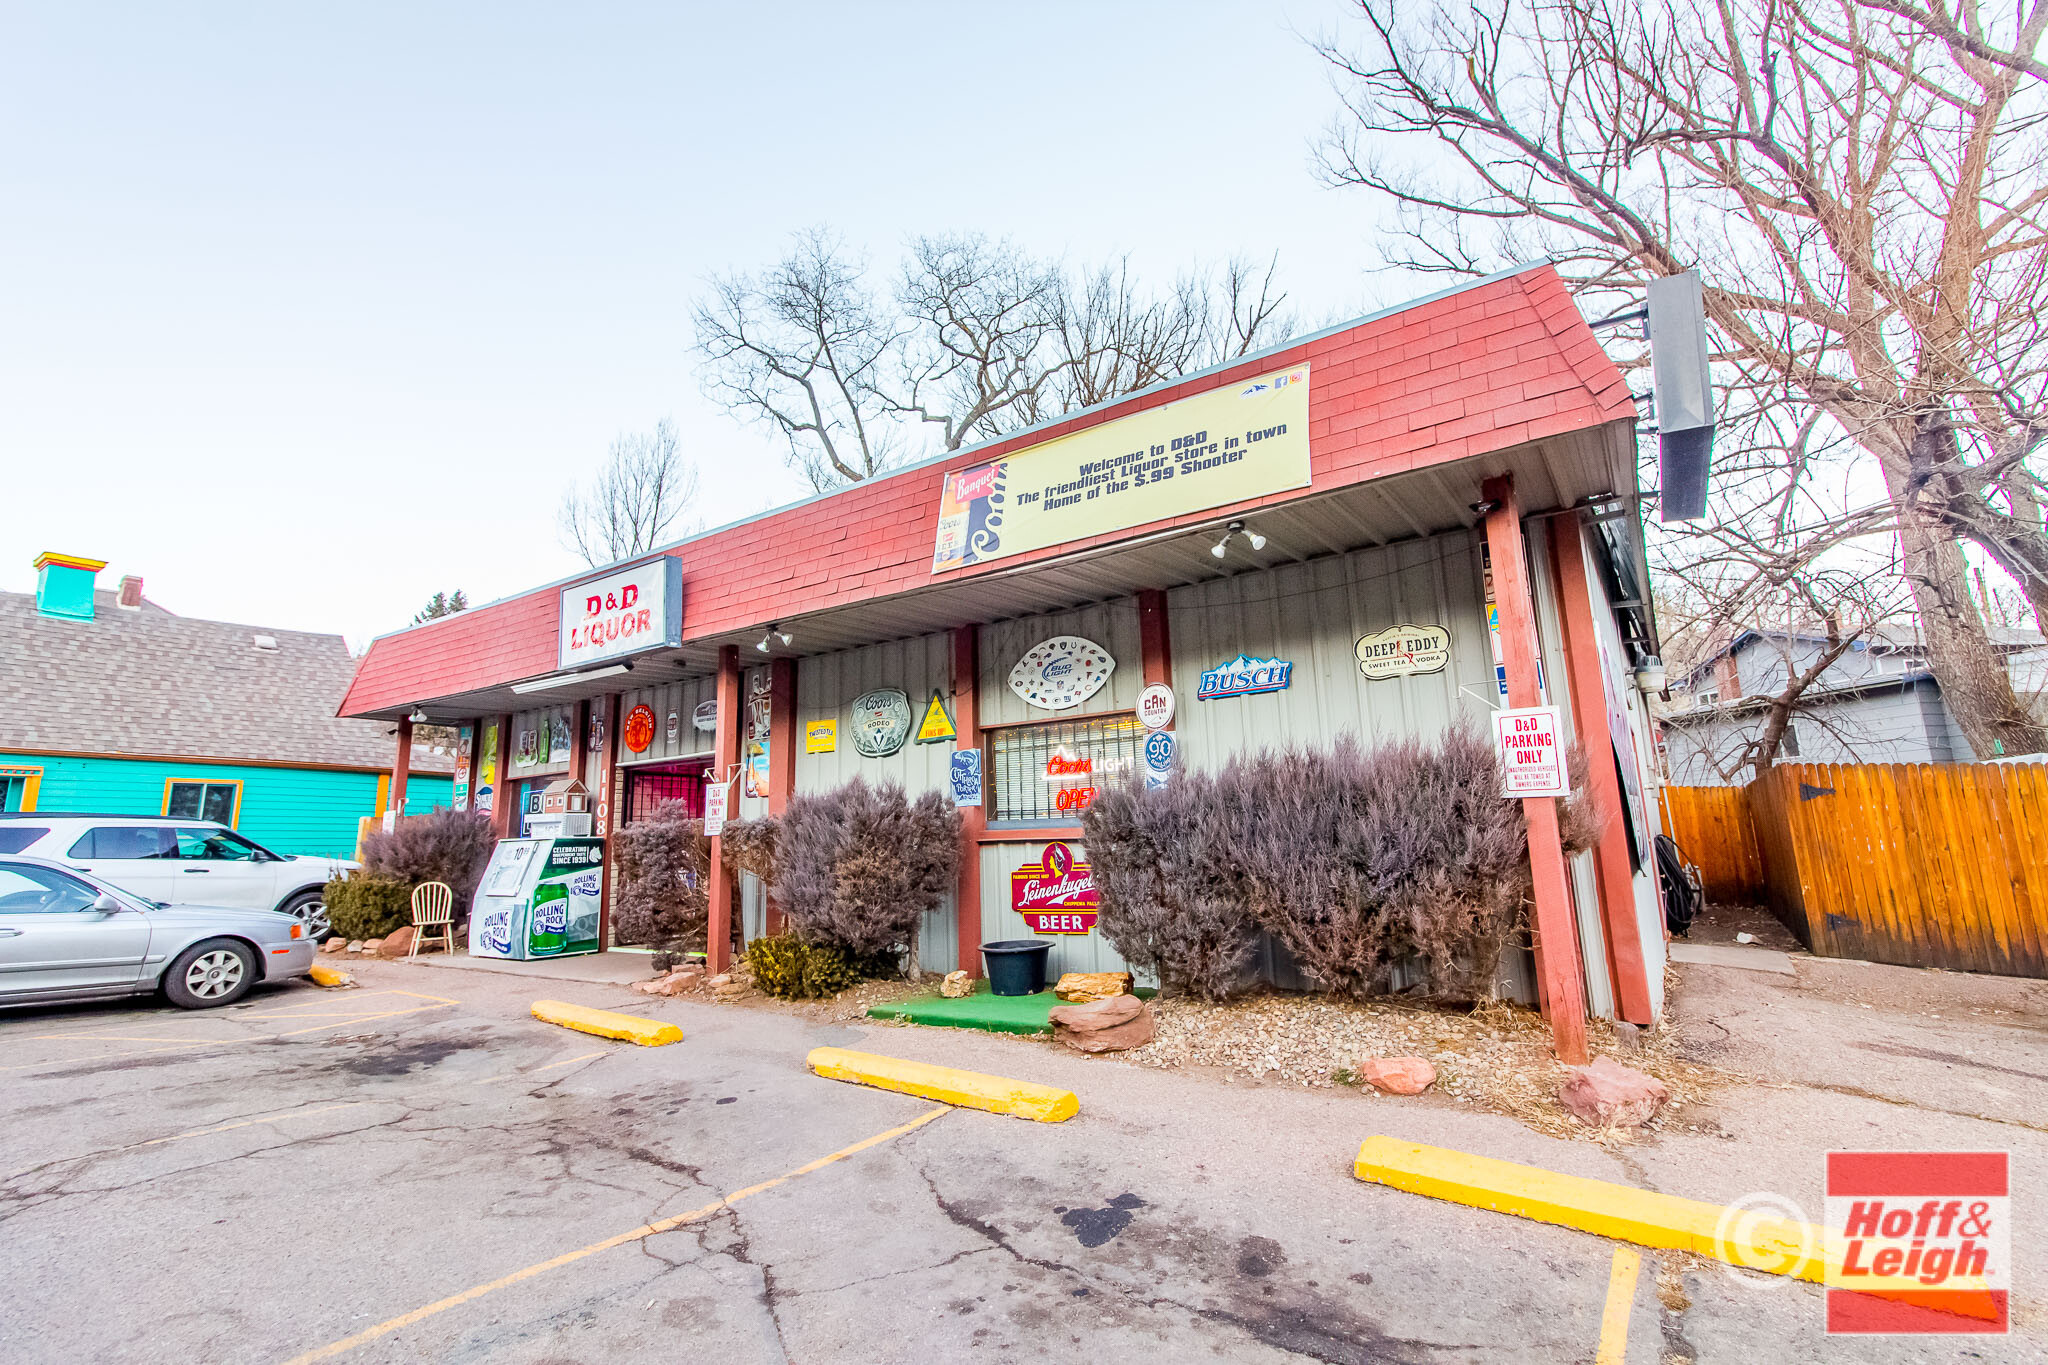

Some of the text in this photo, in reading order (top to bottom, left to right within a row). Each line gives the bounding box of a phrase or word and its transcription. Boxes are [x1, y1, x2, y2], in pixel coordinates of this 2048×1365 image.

[1080, 430, 1207, 476] Welcome to D&D
[1017, 424, 1287, 505] The friendliest Liquor store in town
[957, 468, 995, 500] Banquet
[1044, 449, 1247, 511] Home of the $.99 Shooter
[571, 609, 651, 650] LIQUOR
[1365, 636, 1439, 658] DEEP EDDY
[1046, 669, 1073, 677] LIGHT
[1368, 661, 1390, 669] SWEET
[1202, 667, 1285, 692] BUSCH
[865, 695, 893, 711] Coors
[1144, 695, 1166, 709] CAN
[1144, 709, 1166, 717] COUNTRY
[867, 720, 890, 729] RODEO
[1515, 718, 1537, 731] D&D
[1505, 733, 1552, 748] PARKING
[1149, 740, 1171, 758] 90
[1517, 750, 1542, 764] ONLY
[1047, 755, 1092, 775] Coors
[1093, 757, 1134, 773] LIGHT
[596, 769, 608, 835] 1108
[1056, 786, 1101, 811] OPEN
[574, 874, 596, 884] ROLLING
[536, 904, 564, 918] ROLLING
[484, 911, 508, 928] ROLLING
[546, 916, 563, 924] ROCK
[1039, 915, 1083, 930] BEER
[492, 925, 507, 940] ROCK
